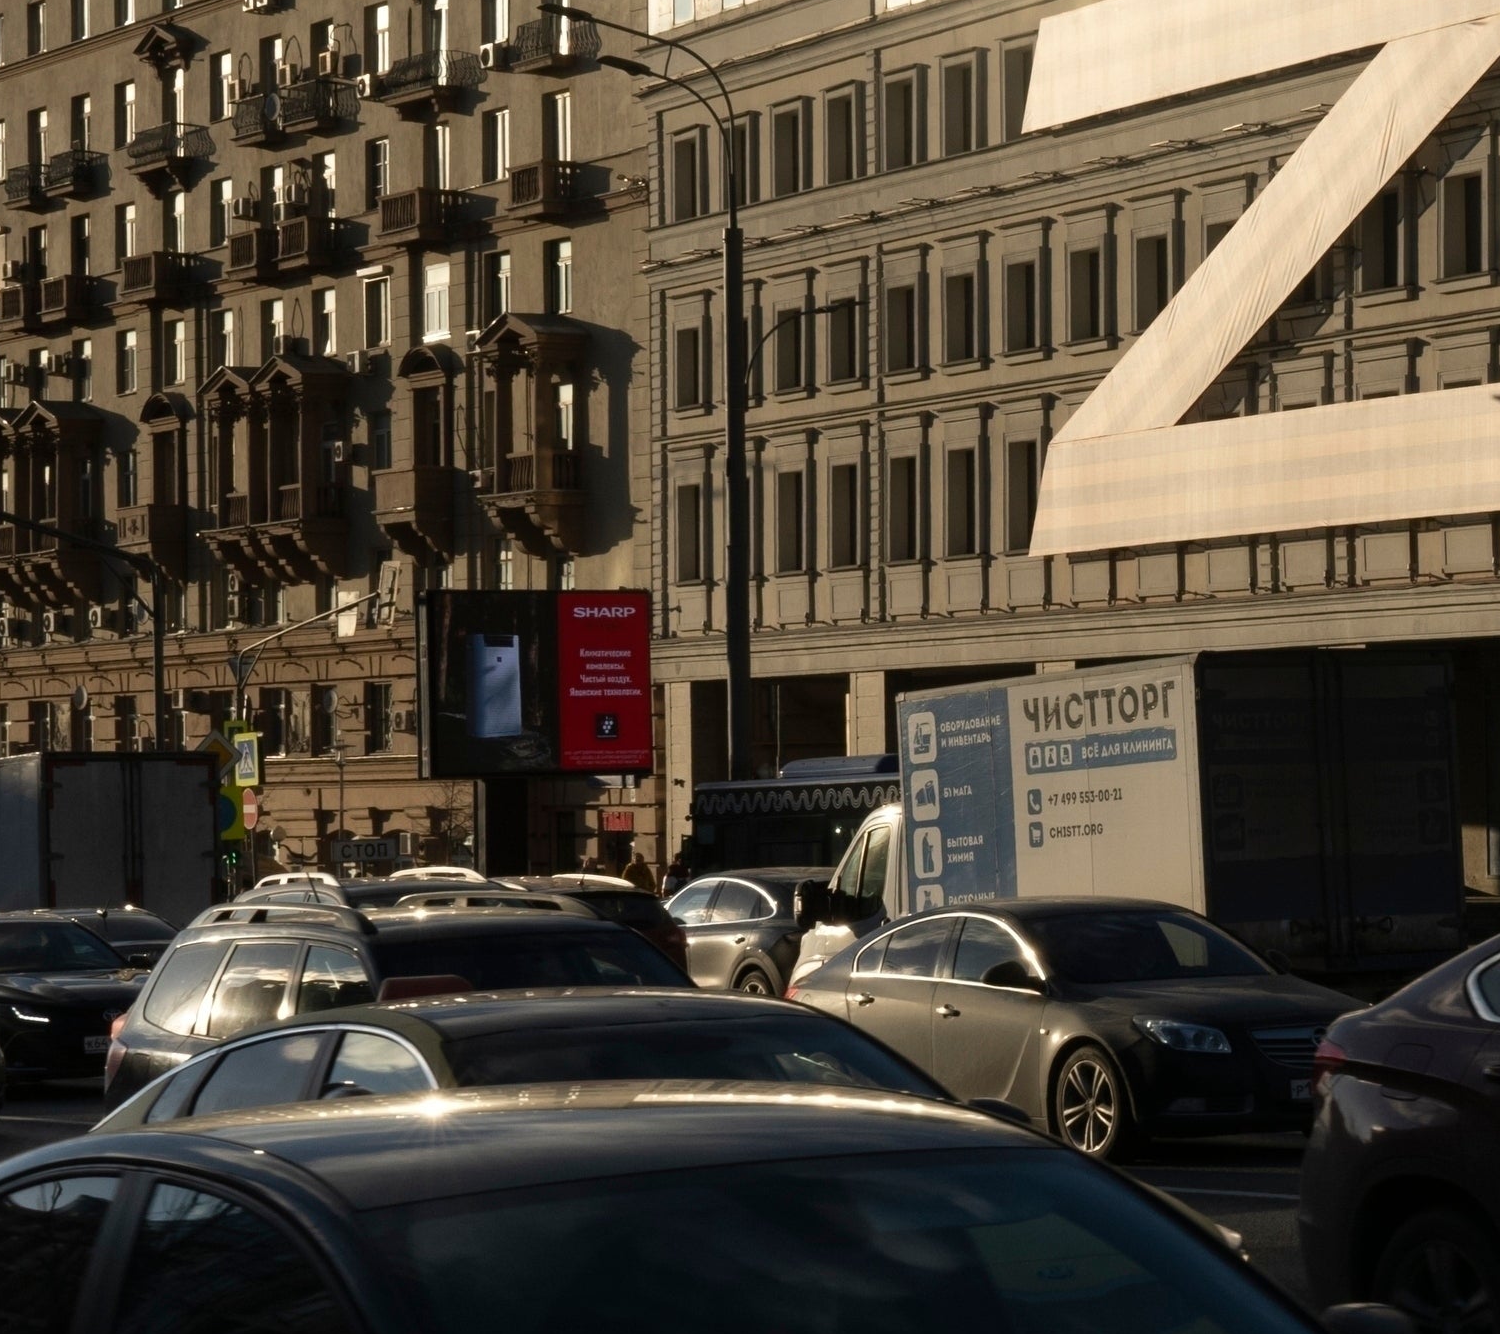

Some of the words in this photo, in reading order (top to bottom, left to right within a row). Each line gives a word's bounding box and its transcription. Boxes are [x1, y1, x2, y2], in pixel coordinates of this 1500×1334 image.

[573, 607, 636, 618] SHARP
[579, 648, 632, 657] Климатические
[579, 674, 606, 683] Чистый
[607, 675, 632, 684] воздух.
[569, 687, 602, 696] Японские
[604, 688, 643, 696] технологии.
[1022, 680, 1175, 733] ЧИСТТОРГ
[940, 715, 1001, 733] ОБОРУДОВАНИЕ
[941, 737, 947, 747] И
[948, 732, 992, 747] ИНВЕНТАРЬ
[1081, 742, 1100, 759] ВСЁ
[1101, 742, 1121, 758] ДЛЯ
[1122, 737, 1174, 755] КЛИНИНГА
[1047, 793, 1059, 806] +7
[1061, 792, 1077, 805] 499
[1079, 788, 1123, 804] 553-00-21
[946, 834, 984, 848] БЫТОВАЯ
[341, 843, 388, 859] СТОП
[947, 851, 975, 864] ХИМИЯ
